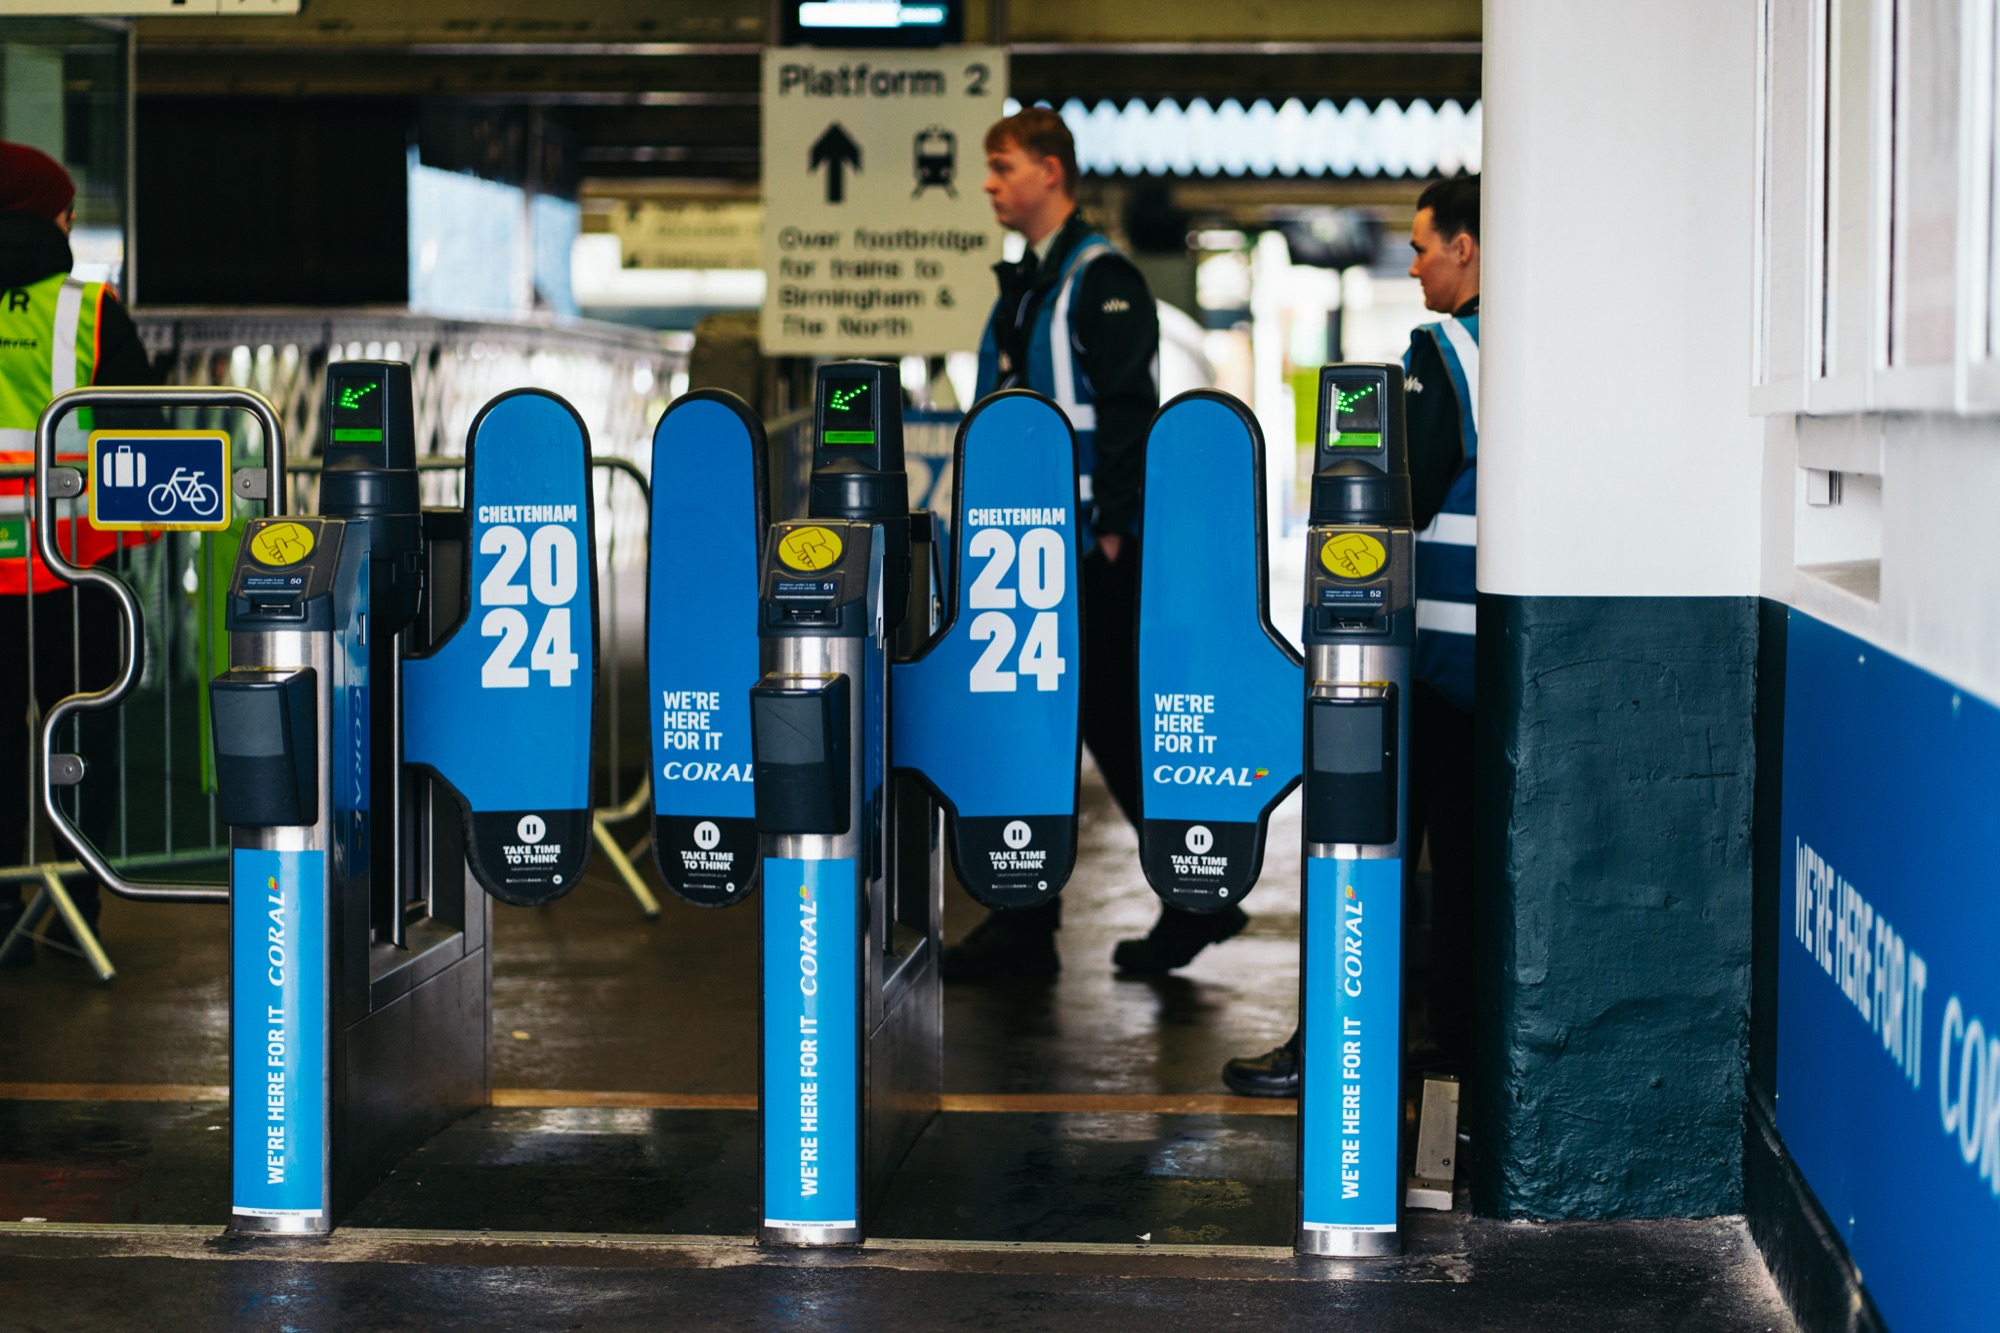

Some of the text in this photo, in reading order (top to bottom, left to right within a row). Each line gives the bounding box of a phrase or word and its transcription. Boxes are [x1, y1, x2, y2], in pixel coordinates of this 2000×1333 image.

[779, 63, 991, 97] Platform 2
[779, 226, 841, 251] Over
[854, 227, 988, 256] footbridge
[779, 257, 816, 280] for
[830, 257, 903, 280] trains
[914, 257, 944, 280] to
[779, 285, 956, 312] Birmingham &
[783, 314, 911, 338] The North
[479, 505, 577, 523] CHELTENHAM
[968, 508, 1066, 526] CHELTENHAM
[480, 525, 578, 606] 20
[969, 528, 1065, 609] 20
[481, 608, 579, 688] 24
[969, 611, 1066, 692] 24
[663, 691, 720, 711] WE'RE
[1154, 693, 1215, 713] WE'RE
[663, 711, 710, 730] HERE
[1154, 714, 1204, 733] HERE
[663, 731, 723, 751] FOR IT
[1154, 734, 1217, 754] FOR IT
[663, 762, 754, 782] CORAL
[1153, 765, 1253, 786] CORAL
[503, 844, 561, 855] TAKE TIME
[506, 854, 558, 864] TO THINK
[681, 851, 734, 861] TAKE TIME
[989, 851, 1046, 860] TAKE TIME
[684, 860, 731, 870] TO THINK
[992, 860, 1043, 870] TO THINK
[1171, 855, 1228, 866] TAKE TIME
[1174, 865, 1224, 876] TO THINK
[268, 892, 285, 987] CORAL
[800, 901, 818, 996] CORAL
[1344, 901, 1362, 998] CORAL
[1796, 835, 1927, 1090] WE'RE HERE FOR IT
[267, 1005, 285, 1184] WE'RE HERE FOR IT
[800, 1015, 818, 1196] WE'RE HERE FOR IT
[1342, 1016, 1361, 1200] WE'RE HERE FOR IT
